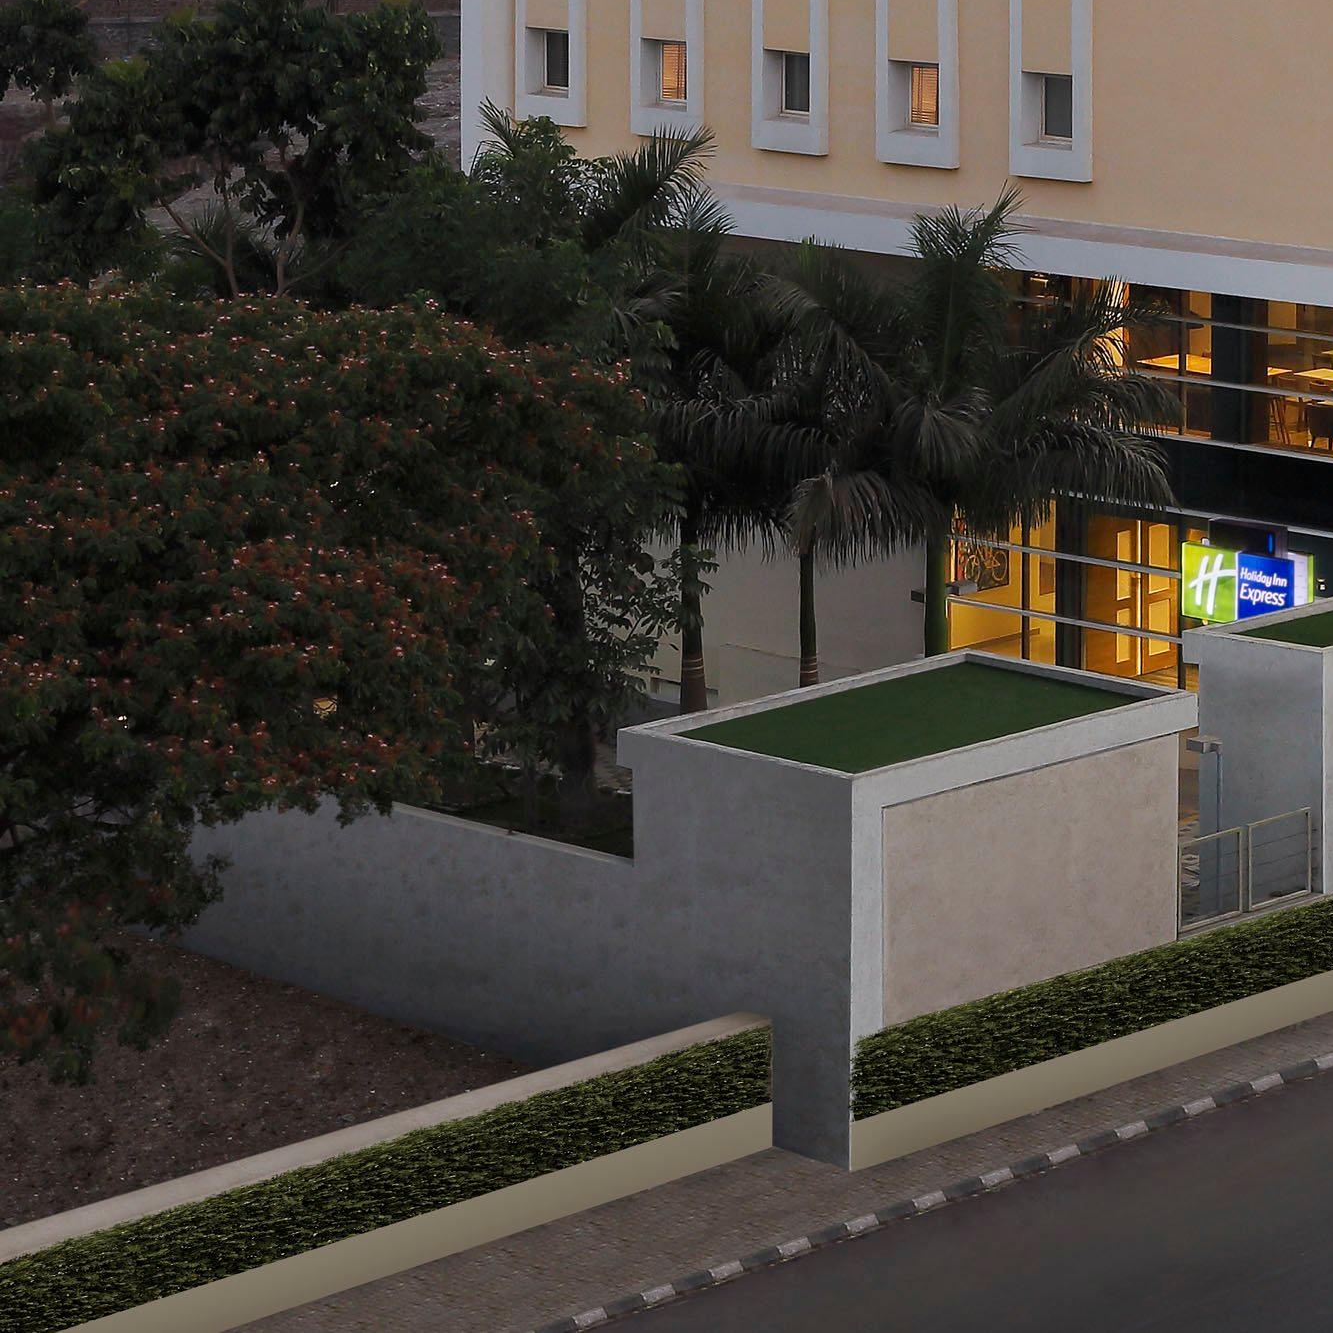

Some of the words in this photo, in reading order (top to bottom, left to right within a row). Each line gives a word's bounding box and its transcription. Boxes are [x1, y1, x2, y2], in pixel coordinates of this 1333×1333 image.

[1240, 567, 1273, 587] Holiday
[1273, 573, 1288, 587] Inn
[1240, 583, 1287, 606] Express
